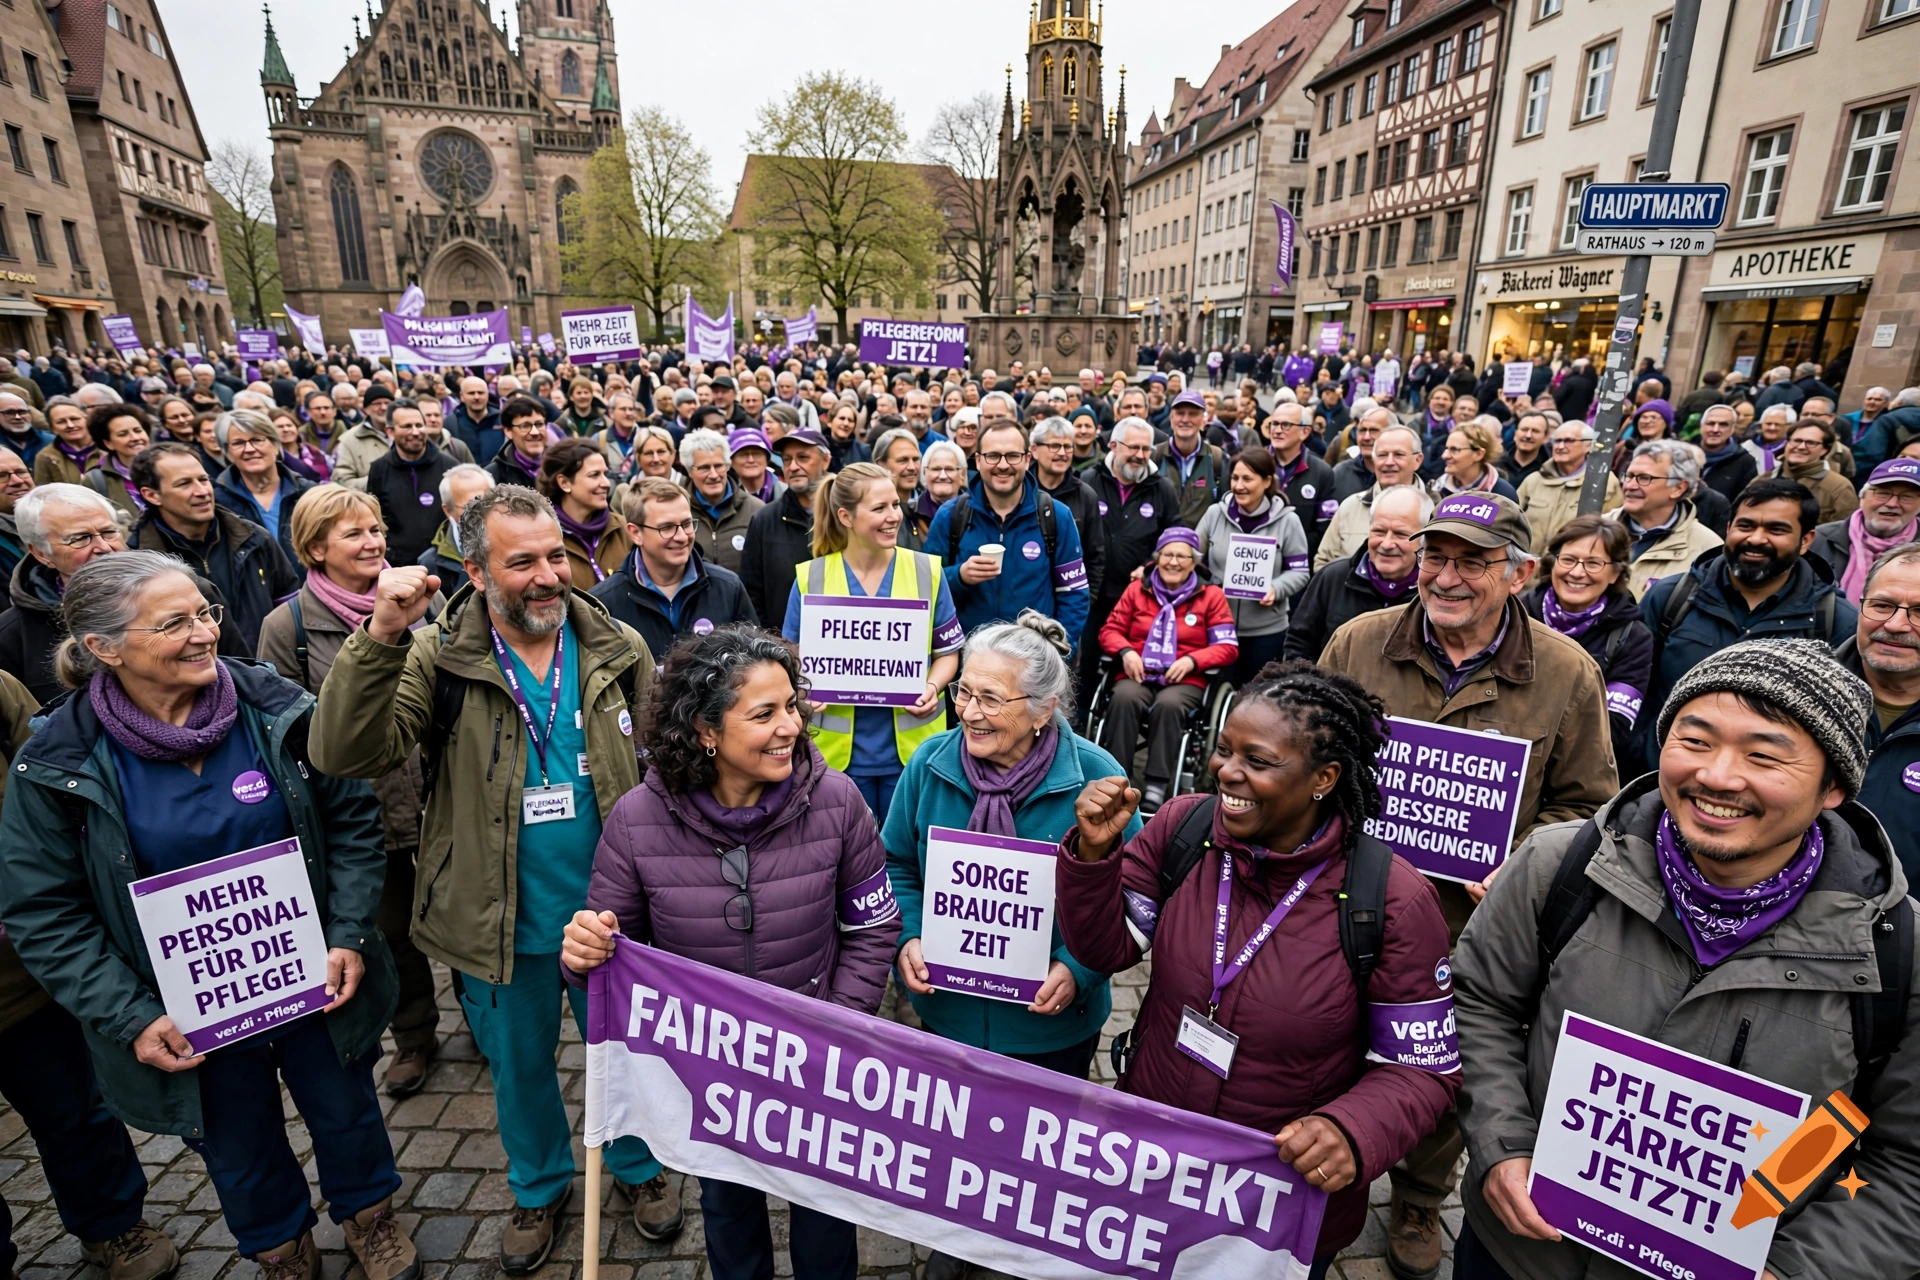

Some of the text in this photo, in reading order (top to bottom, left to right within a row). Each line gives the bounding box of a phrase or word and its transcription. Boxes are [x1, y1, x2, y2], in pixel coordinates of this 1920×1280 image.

[1589, 193, 1720, 220] HAUPTMARKT
[1587, 236, 1704, 250] RATHAUS 120 m
[1730, 244, 1855, 278] APOTHEKE
[1497, 269, 1554, 296] Bäckerei
[569, 316, 628, 333] MEHR ZEIT
[570, 333, 633, 349] FÜR PFLEGE
[863, 321, 965, 343] PFLEGEREFORM
[886, 341, 937, 363] JETZ!
[1442, 503, 1493, 519] ver.di
[1234, 547, 1268, 560] GENUG
[1242, 562, 1257, 572] IST
[1231, 574, 1265, 587] GENUG
[821, 619, 912, 642] PFLEGE IST
[802, 656, 922, 678] SYSTEMRELEVANT
[1416, 746, 1506, 782] PFLEGEN
[233, 776, 267, 794] ver.di
[1410, 772, 1507, 812] FORDERN
[1386, 795, 1471, 832] BESSERE
[1363, 817, 1497, 865] BEDINGUNGEN
[951, 860, 1029, 895] SORGE
[184, 874, 268, 918] MEHR
[934, 891, 1044, 931] BRAUCHT
[159, 896, 307, 960] PERSONAL
[960, 929, 1010, 960] ZEIT
[188, 930, 297, 985] FÜR DIE
[195, 959, 306, 1016] PFLEGE!
[215, 1017, 255, 1040] ver.di
[264, 1000, 306, 1022] Pflege
[1390, 1008, 1456, 1040] ver.di
[627, 983, 808, 1089] FAIRER
[823, 1045, 971, 1139] LOHN
[1021, 1106, 1293, 1233] RESPEKT
[1589, 1062, 1752, 1153] PFLEGE
[702, 1082, 1168, 1273] SICHERE PFLEGE
[1577, 1149, 1722, 1234] JETZT!
[1577, 1217, 1625, 1249] ver.di
[1639, 1244, 1697, 1280] Pflege
